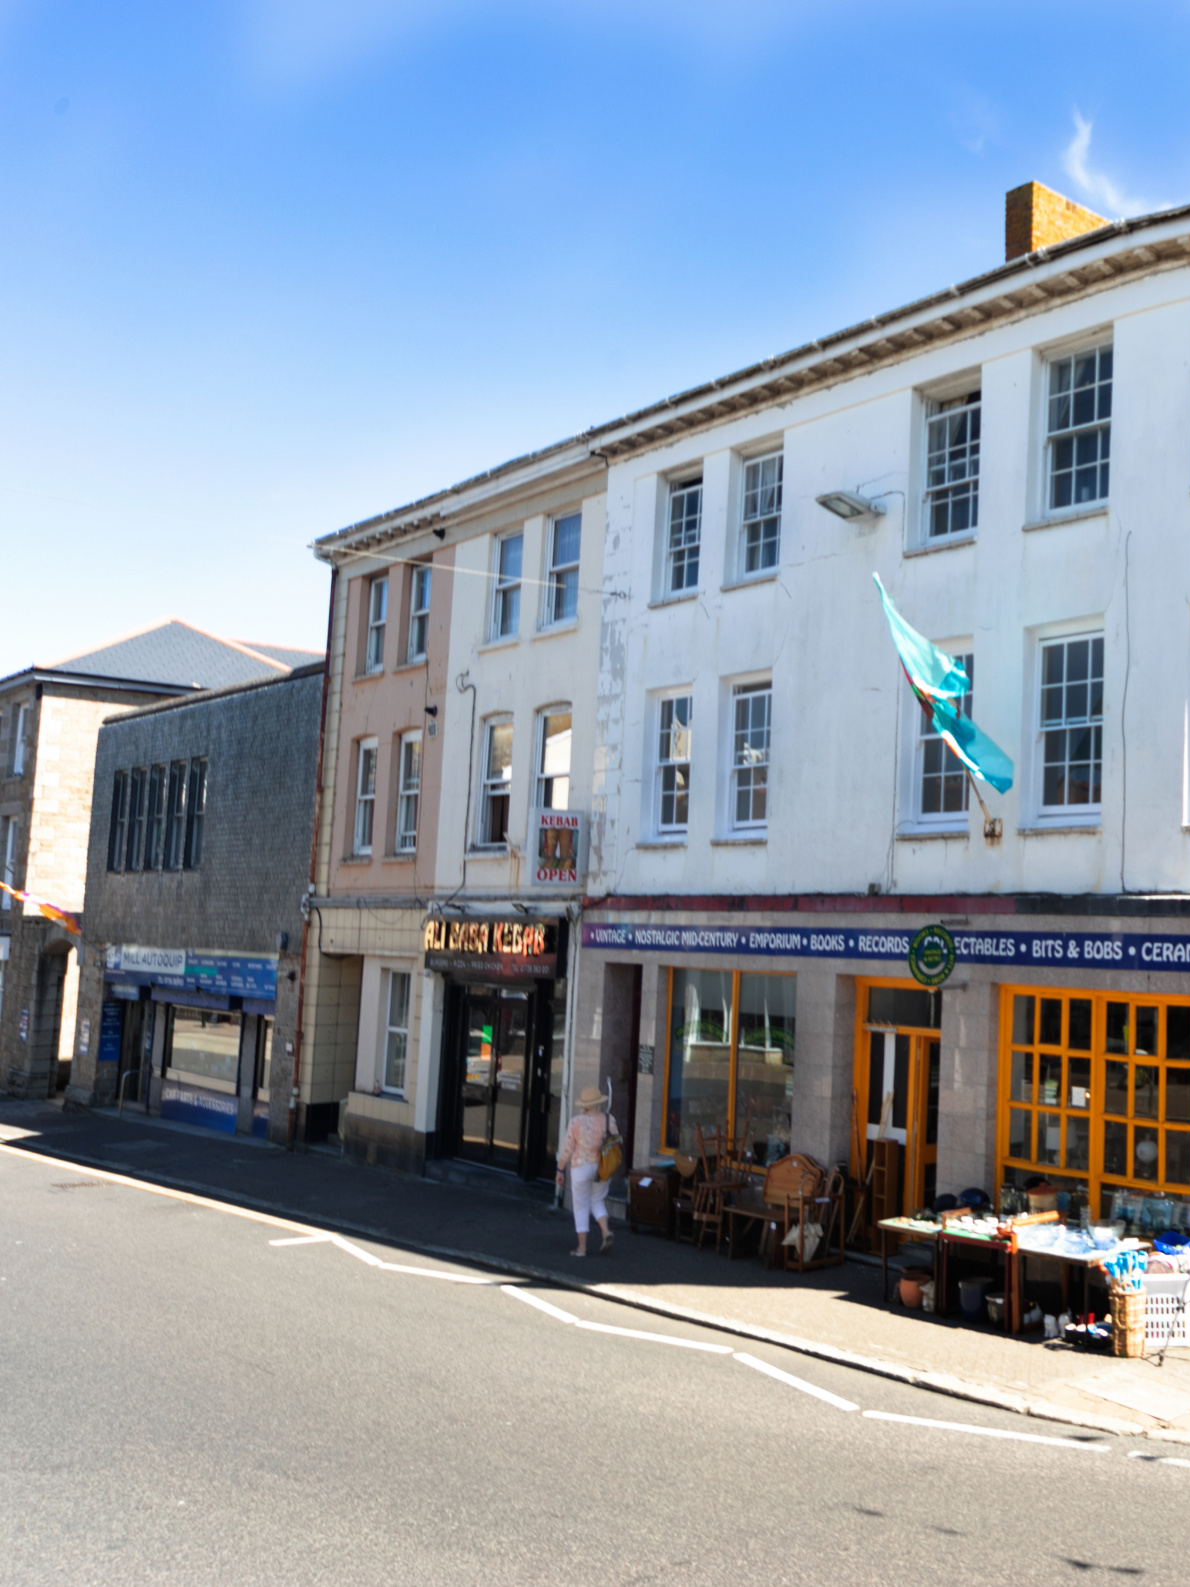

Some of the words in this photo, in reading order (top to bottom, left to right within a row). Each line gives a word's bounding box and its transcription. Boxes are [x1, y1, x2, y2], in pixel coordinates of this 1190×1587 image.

[541, 814, 578, 827] KEBAB
[536, 868, 577, 882] OPEN
[424, 920, 446, 952] ALI
[492, 921, 545, 957] KEBAB
[595, 928, 626, 944] VINTAGE
[635, 930, 679, 946] NOSTALGIC
[681, 931, 739, 948] MID-CENTURY
[750, 933, 801, 950] EMPORIUM
[810, 935, 845, 951] BOOKS
[858, 935, 909, 953] RECORDS
[1032, 939, 1063, 958] BITS
[1067, 940, 1080, 958] &
[1084, 941, 1122, 960] BOBS
[123, 952, 140, 965] MILL
[142, 953, 183, 968] AUTOQUIP
